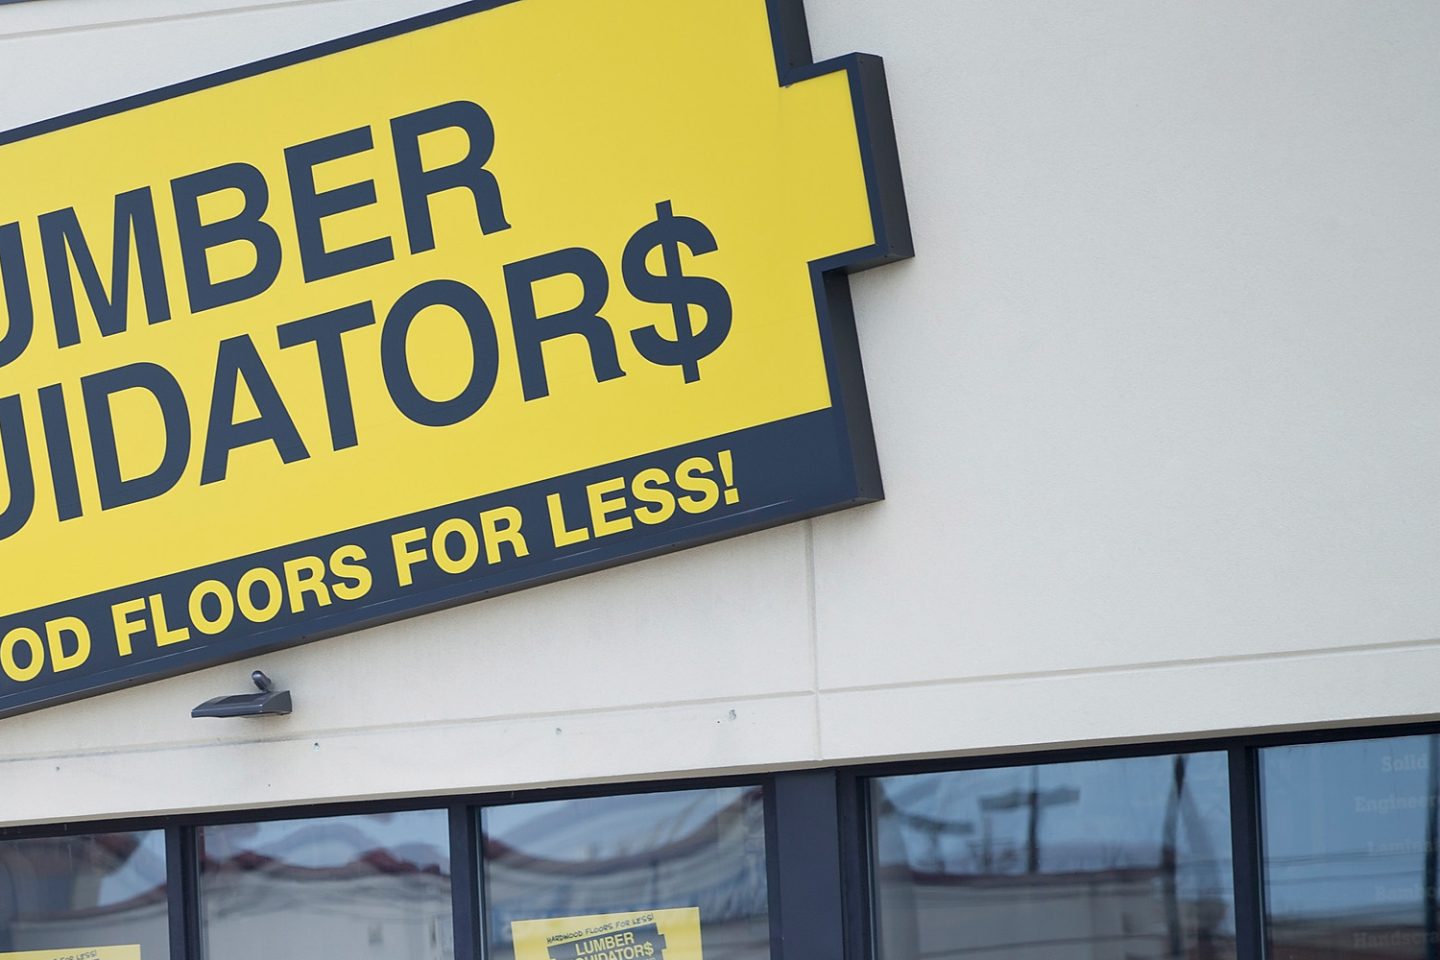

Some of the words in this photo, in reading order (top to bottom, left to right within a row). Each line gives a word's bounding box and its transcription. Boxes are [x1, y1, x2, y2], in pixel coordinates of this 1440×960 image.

[111, 544, 374, 657] FLOORS
[392, 503, 529, 583] FOR
[547, 450, 741, 549] LESS!
[547, 930, 583, 943] HARDWOOD
[585, 923, 613, 935] FLOORS
[616, 919, 630, 928] FOR
[575, 931, 635, 956] LUMBER
